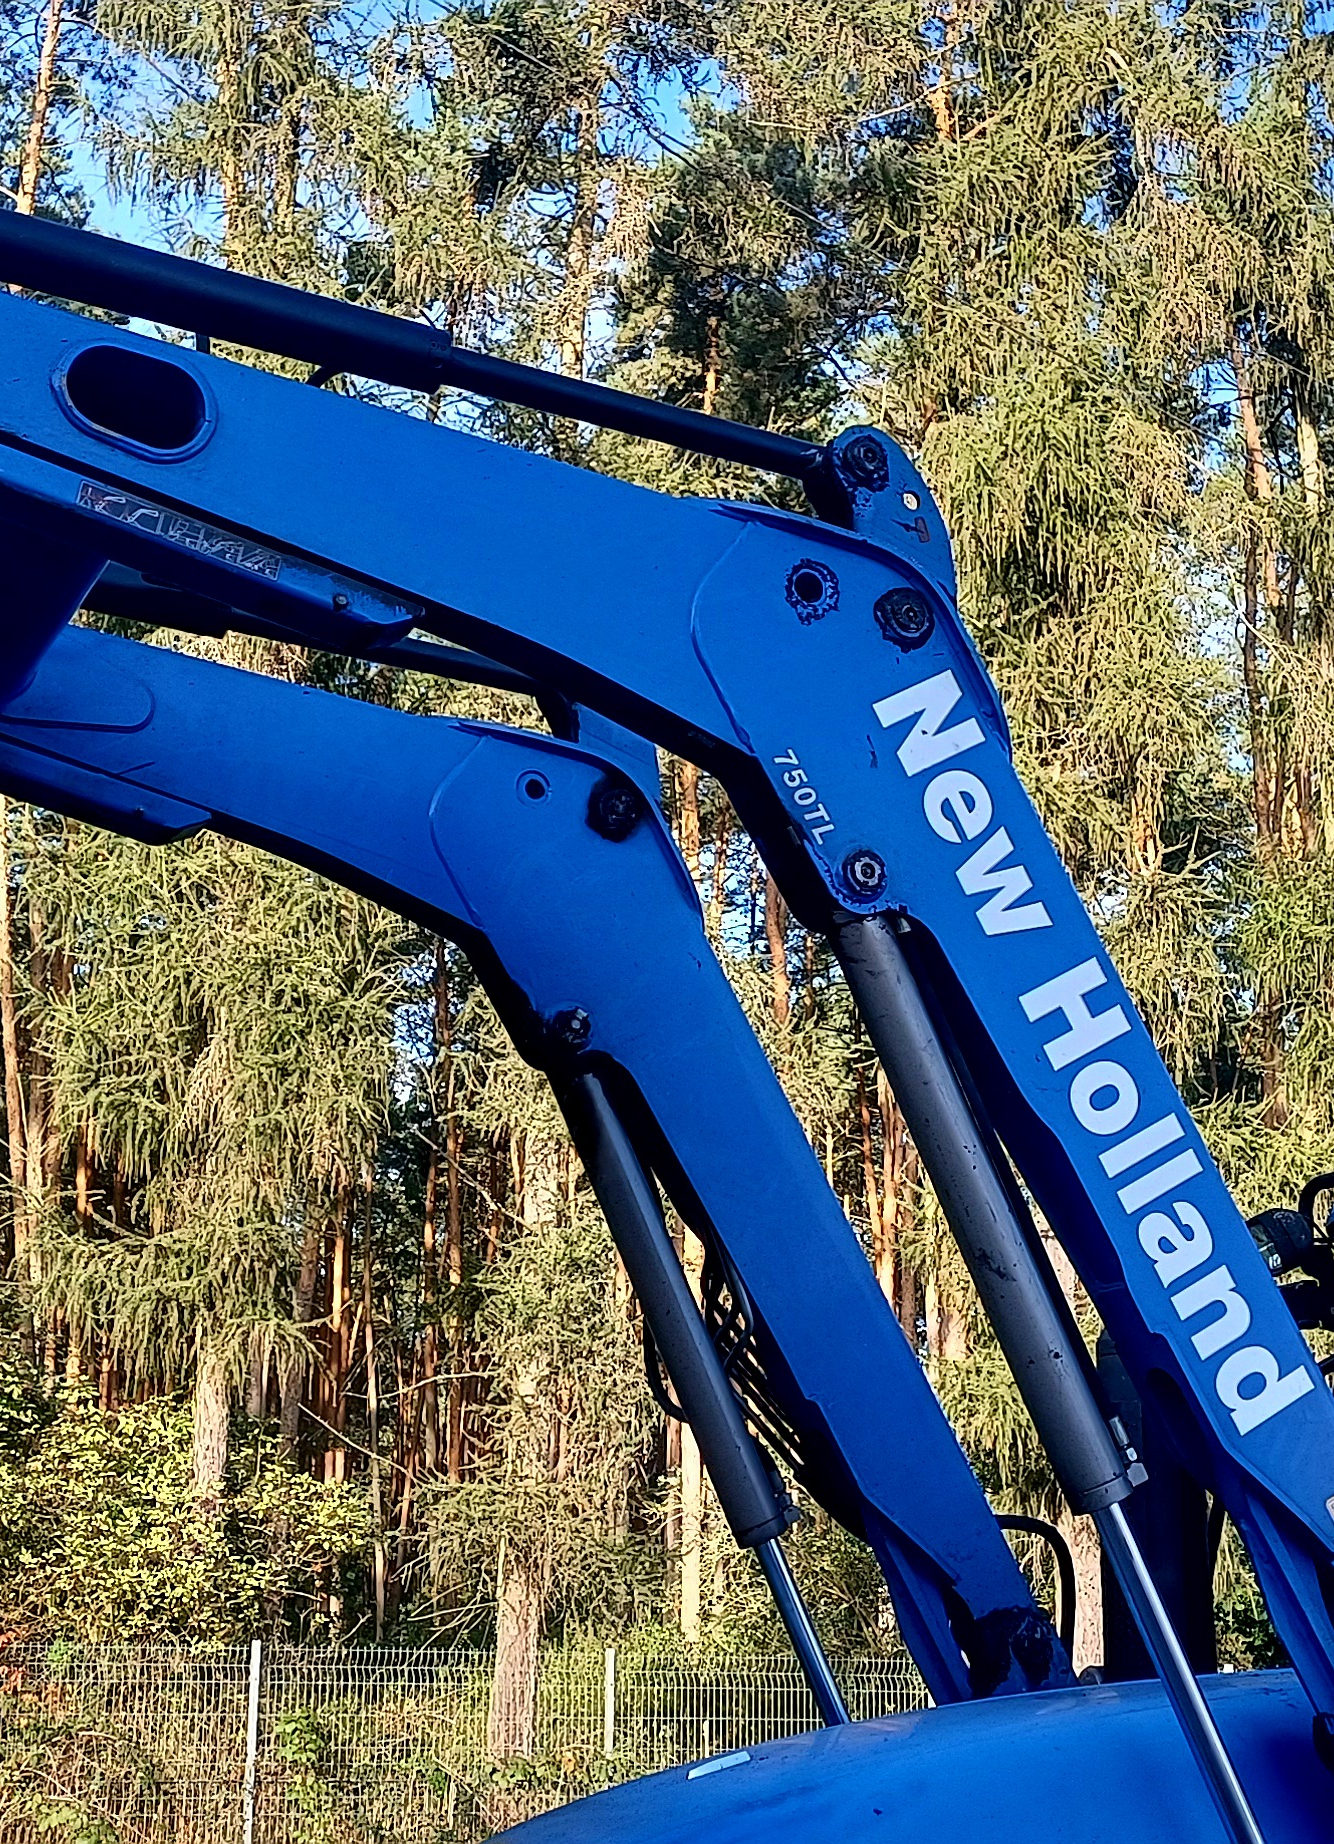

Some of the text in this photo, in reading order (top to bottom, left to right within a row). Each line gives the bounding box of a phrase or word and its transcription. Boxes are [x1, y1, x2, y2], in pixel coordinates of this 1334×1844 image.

[773, 748, 835, 846] 750TL
[873, 669, 1315, 1437] New Holland
